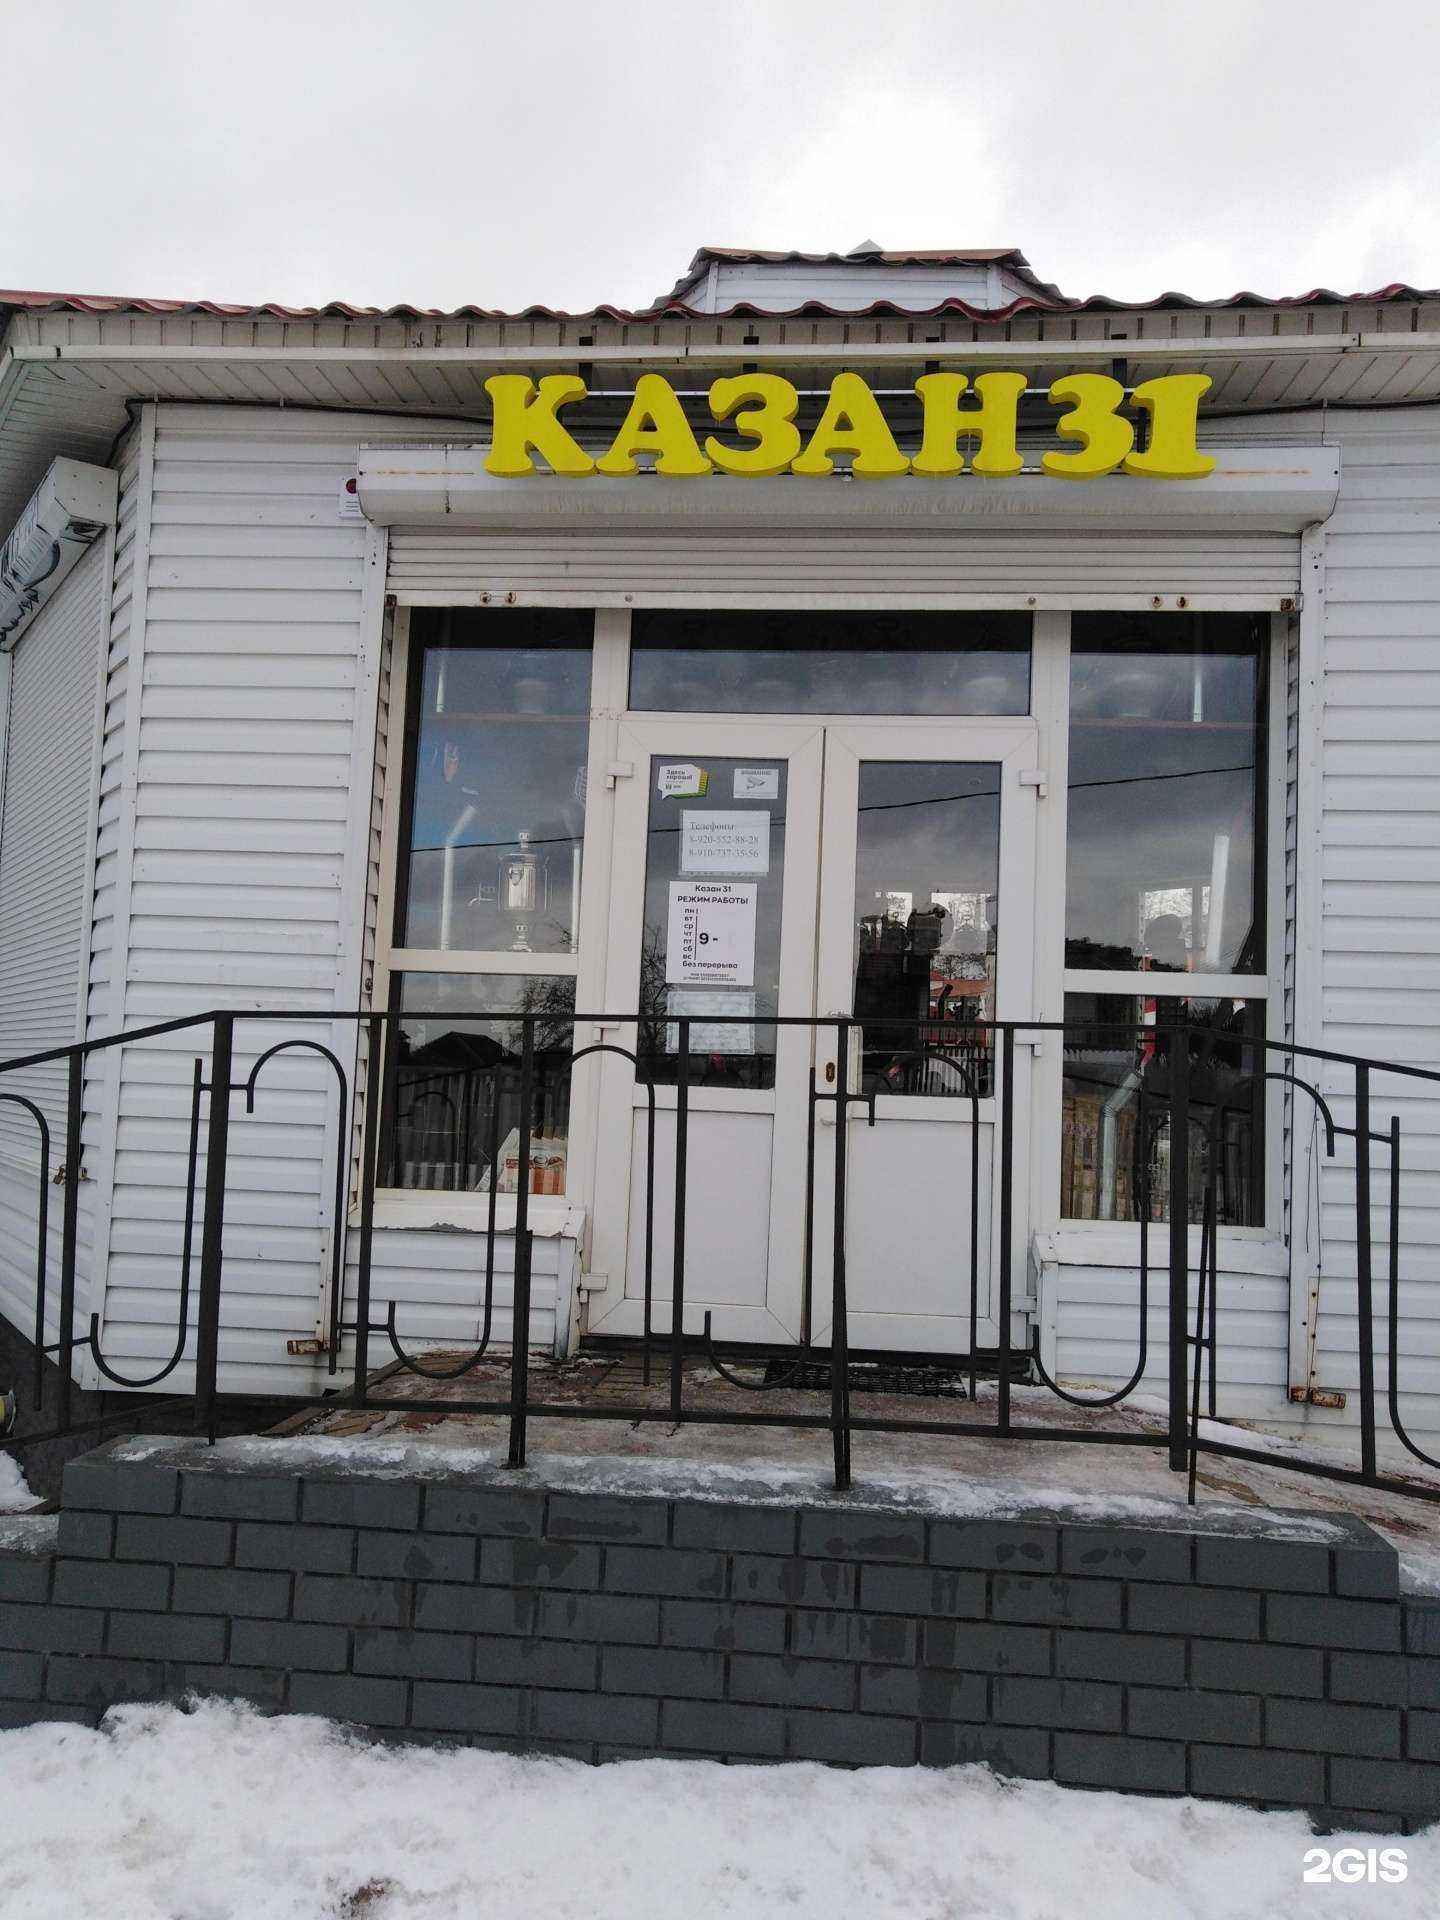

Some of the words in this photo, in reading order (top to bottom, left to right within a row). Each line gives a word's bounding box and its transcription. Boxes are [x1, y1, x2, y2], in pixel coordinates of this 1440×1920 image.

[695, 884, 721, 893] Казан
[722, 885, 732, 894] 31
[677, 895, 711, 904] РЕЖИМ
[712, 896, 749, 905] РАБОТЫ
[683, 923, 694, 931] ср
[682, 945, 693, 953] сб
[697, 962, 738, 970] перерыва
